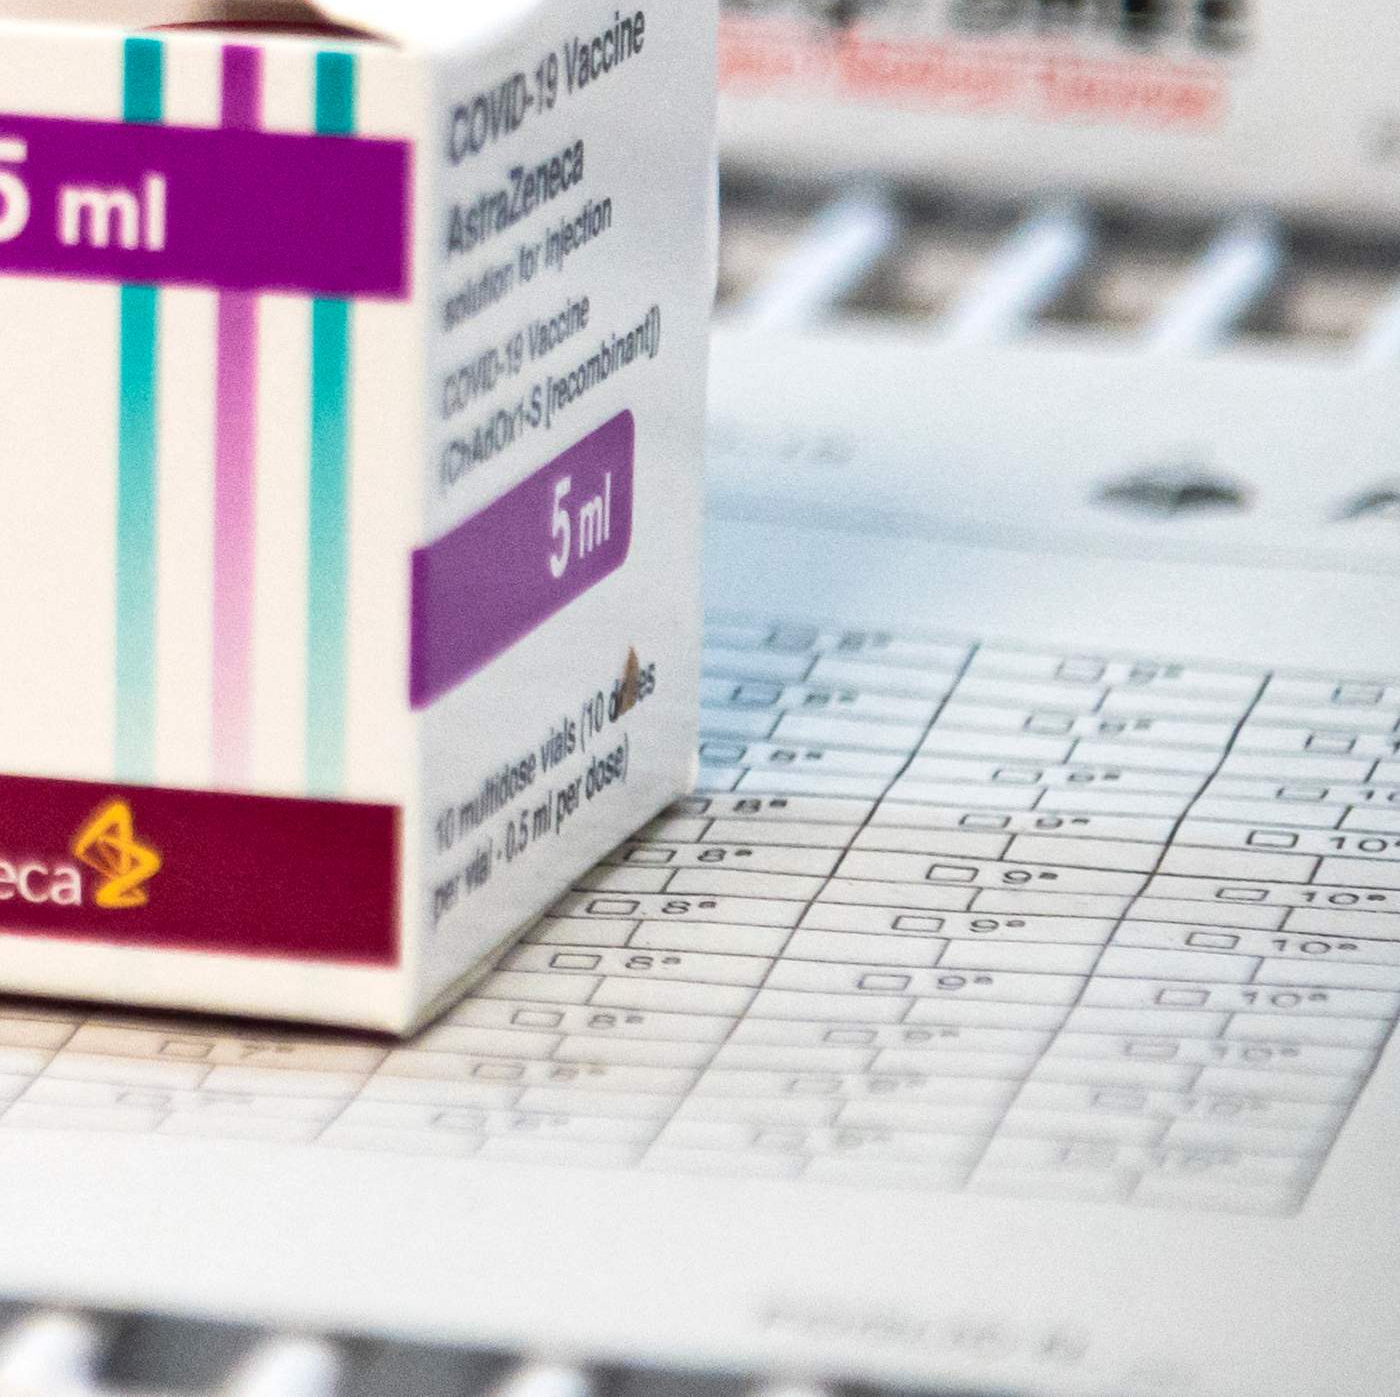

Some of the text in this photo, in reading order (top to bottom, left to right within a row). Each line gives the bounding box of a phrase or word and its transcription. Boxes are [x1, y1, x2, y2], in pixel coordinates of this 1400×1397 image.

[447, 52, 559, 166] COVID-19
[563, 10, 646, 95] Vaccine
[57, 173, 170, 253] ml
[447, 139, 585, 256] AstraZeneca
[545, 197, 613, 272] injection
[527, 296, 591, 360] Vaccine
[548, 471, 612, 579] 5 ml
[458, 753, 537, 842] multidose
[541, 716, 577, 773] vials
[580, 689, 605, 753] (10
[608, 662, 656, 724] des
[505, 809, 530, 862] 0.5
[532, 790, 553, 842] ml
[556, 776, 583, 835] per
[585, 732, 630, 801] dose)
